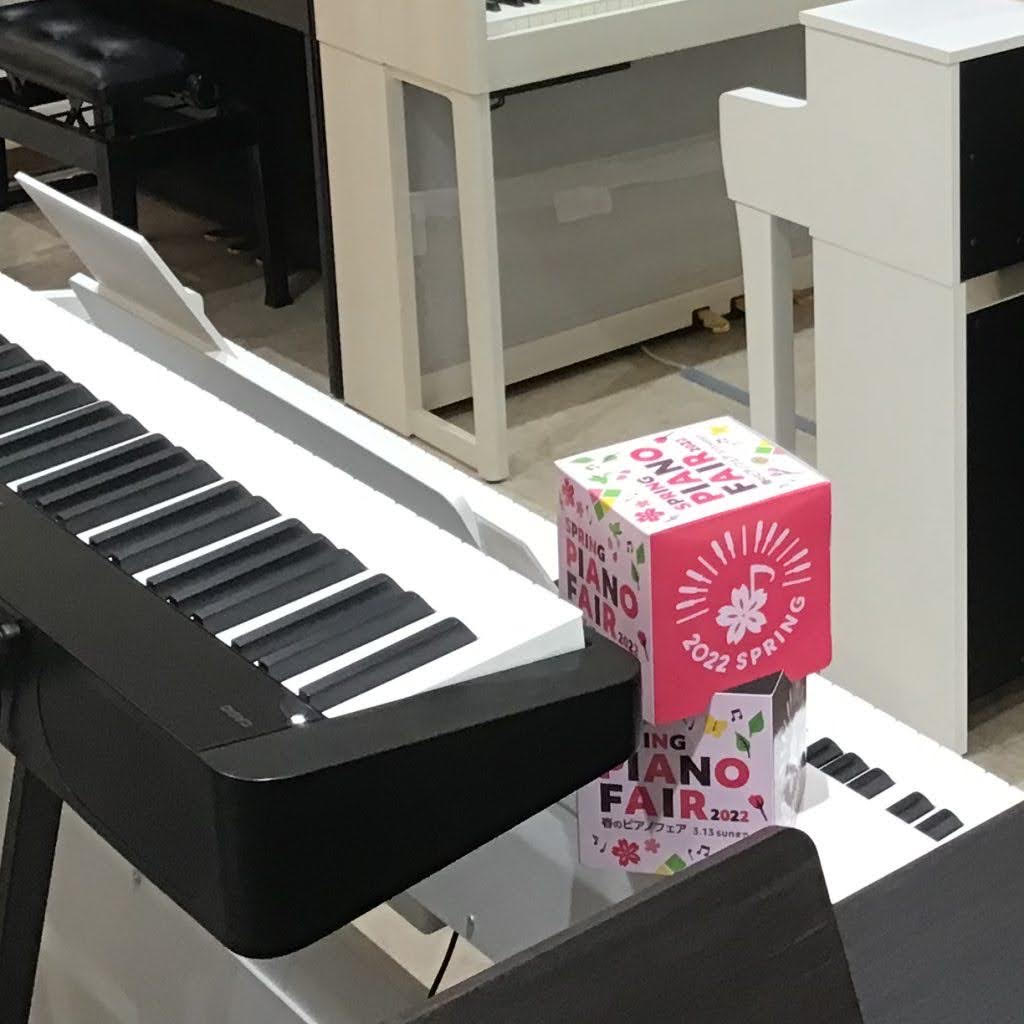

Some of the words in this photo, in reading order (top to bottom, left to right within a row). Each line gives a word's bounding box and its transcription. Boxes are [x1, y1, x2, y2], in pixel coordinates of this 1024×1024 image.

[629, 447, 726, 505] PIANO
[636, 475, 692, 511] SPRING
[682, 450, 758, 496] FAIR
[565, 516, 606, 563] SPRING
[566, 537, 639, 620] PIANO
[566, 570, 617, 641] FAIR
[681, 633, 731, 673] 2022
[735, 595, 806, 671] SPRING
[643, 732, 687, 751] ING
[600, 782, 708, 822] FAIR
[710, 808, 750, 823] 2022
[601, 817, 687, 835] 春のピアノフェア
